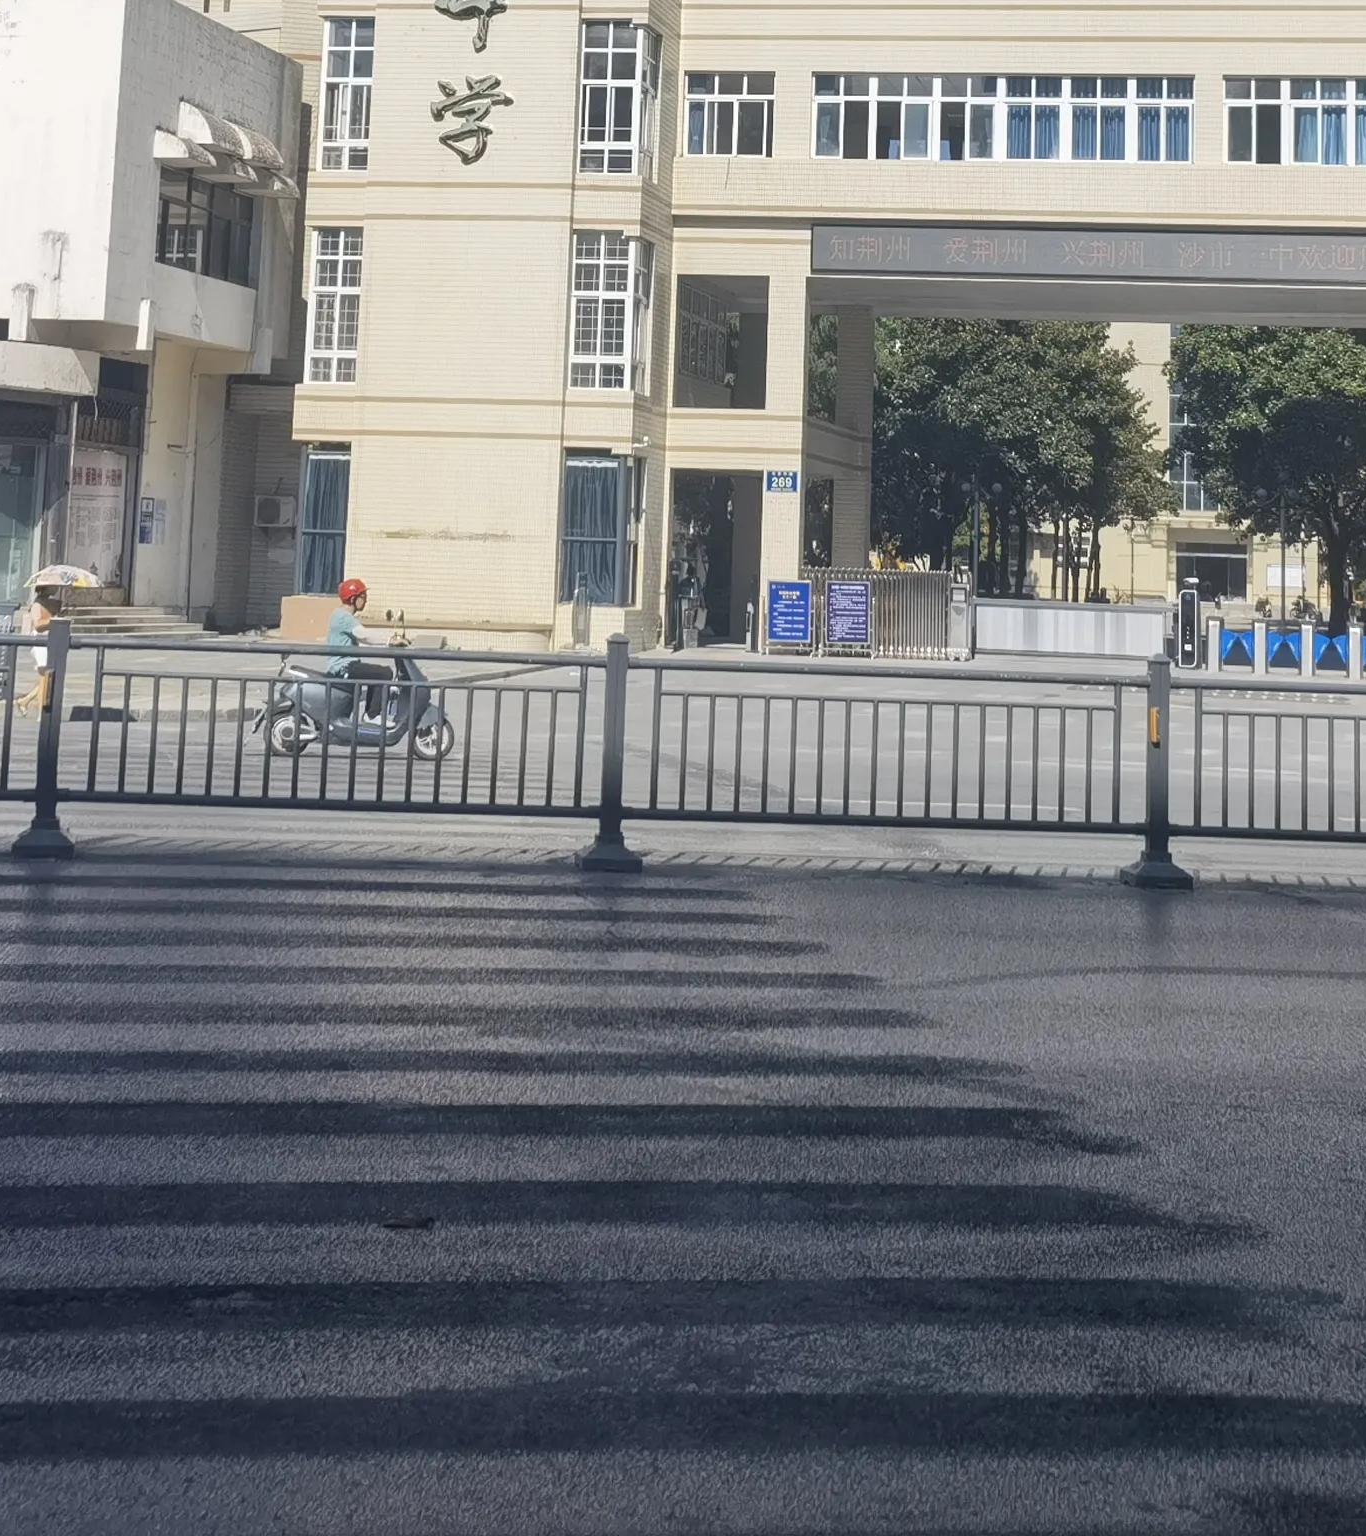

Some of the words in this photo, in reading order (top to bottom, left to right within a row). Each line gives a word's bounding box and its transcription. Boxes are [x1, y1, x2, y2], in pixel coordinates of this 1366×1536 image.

[828, 233, 912, 265] 知荆州
[943, 235, 1028, 267] 爱荆州
[1060, 238, 1145, 269] 兴荆州
[771, 476, 793, 488] 269
